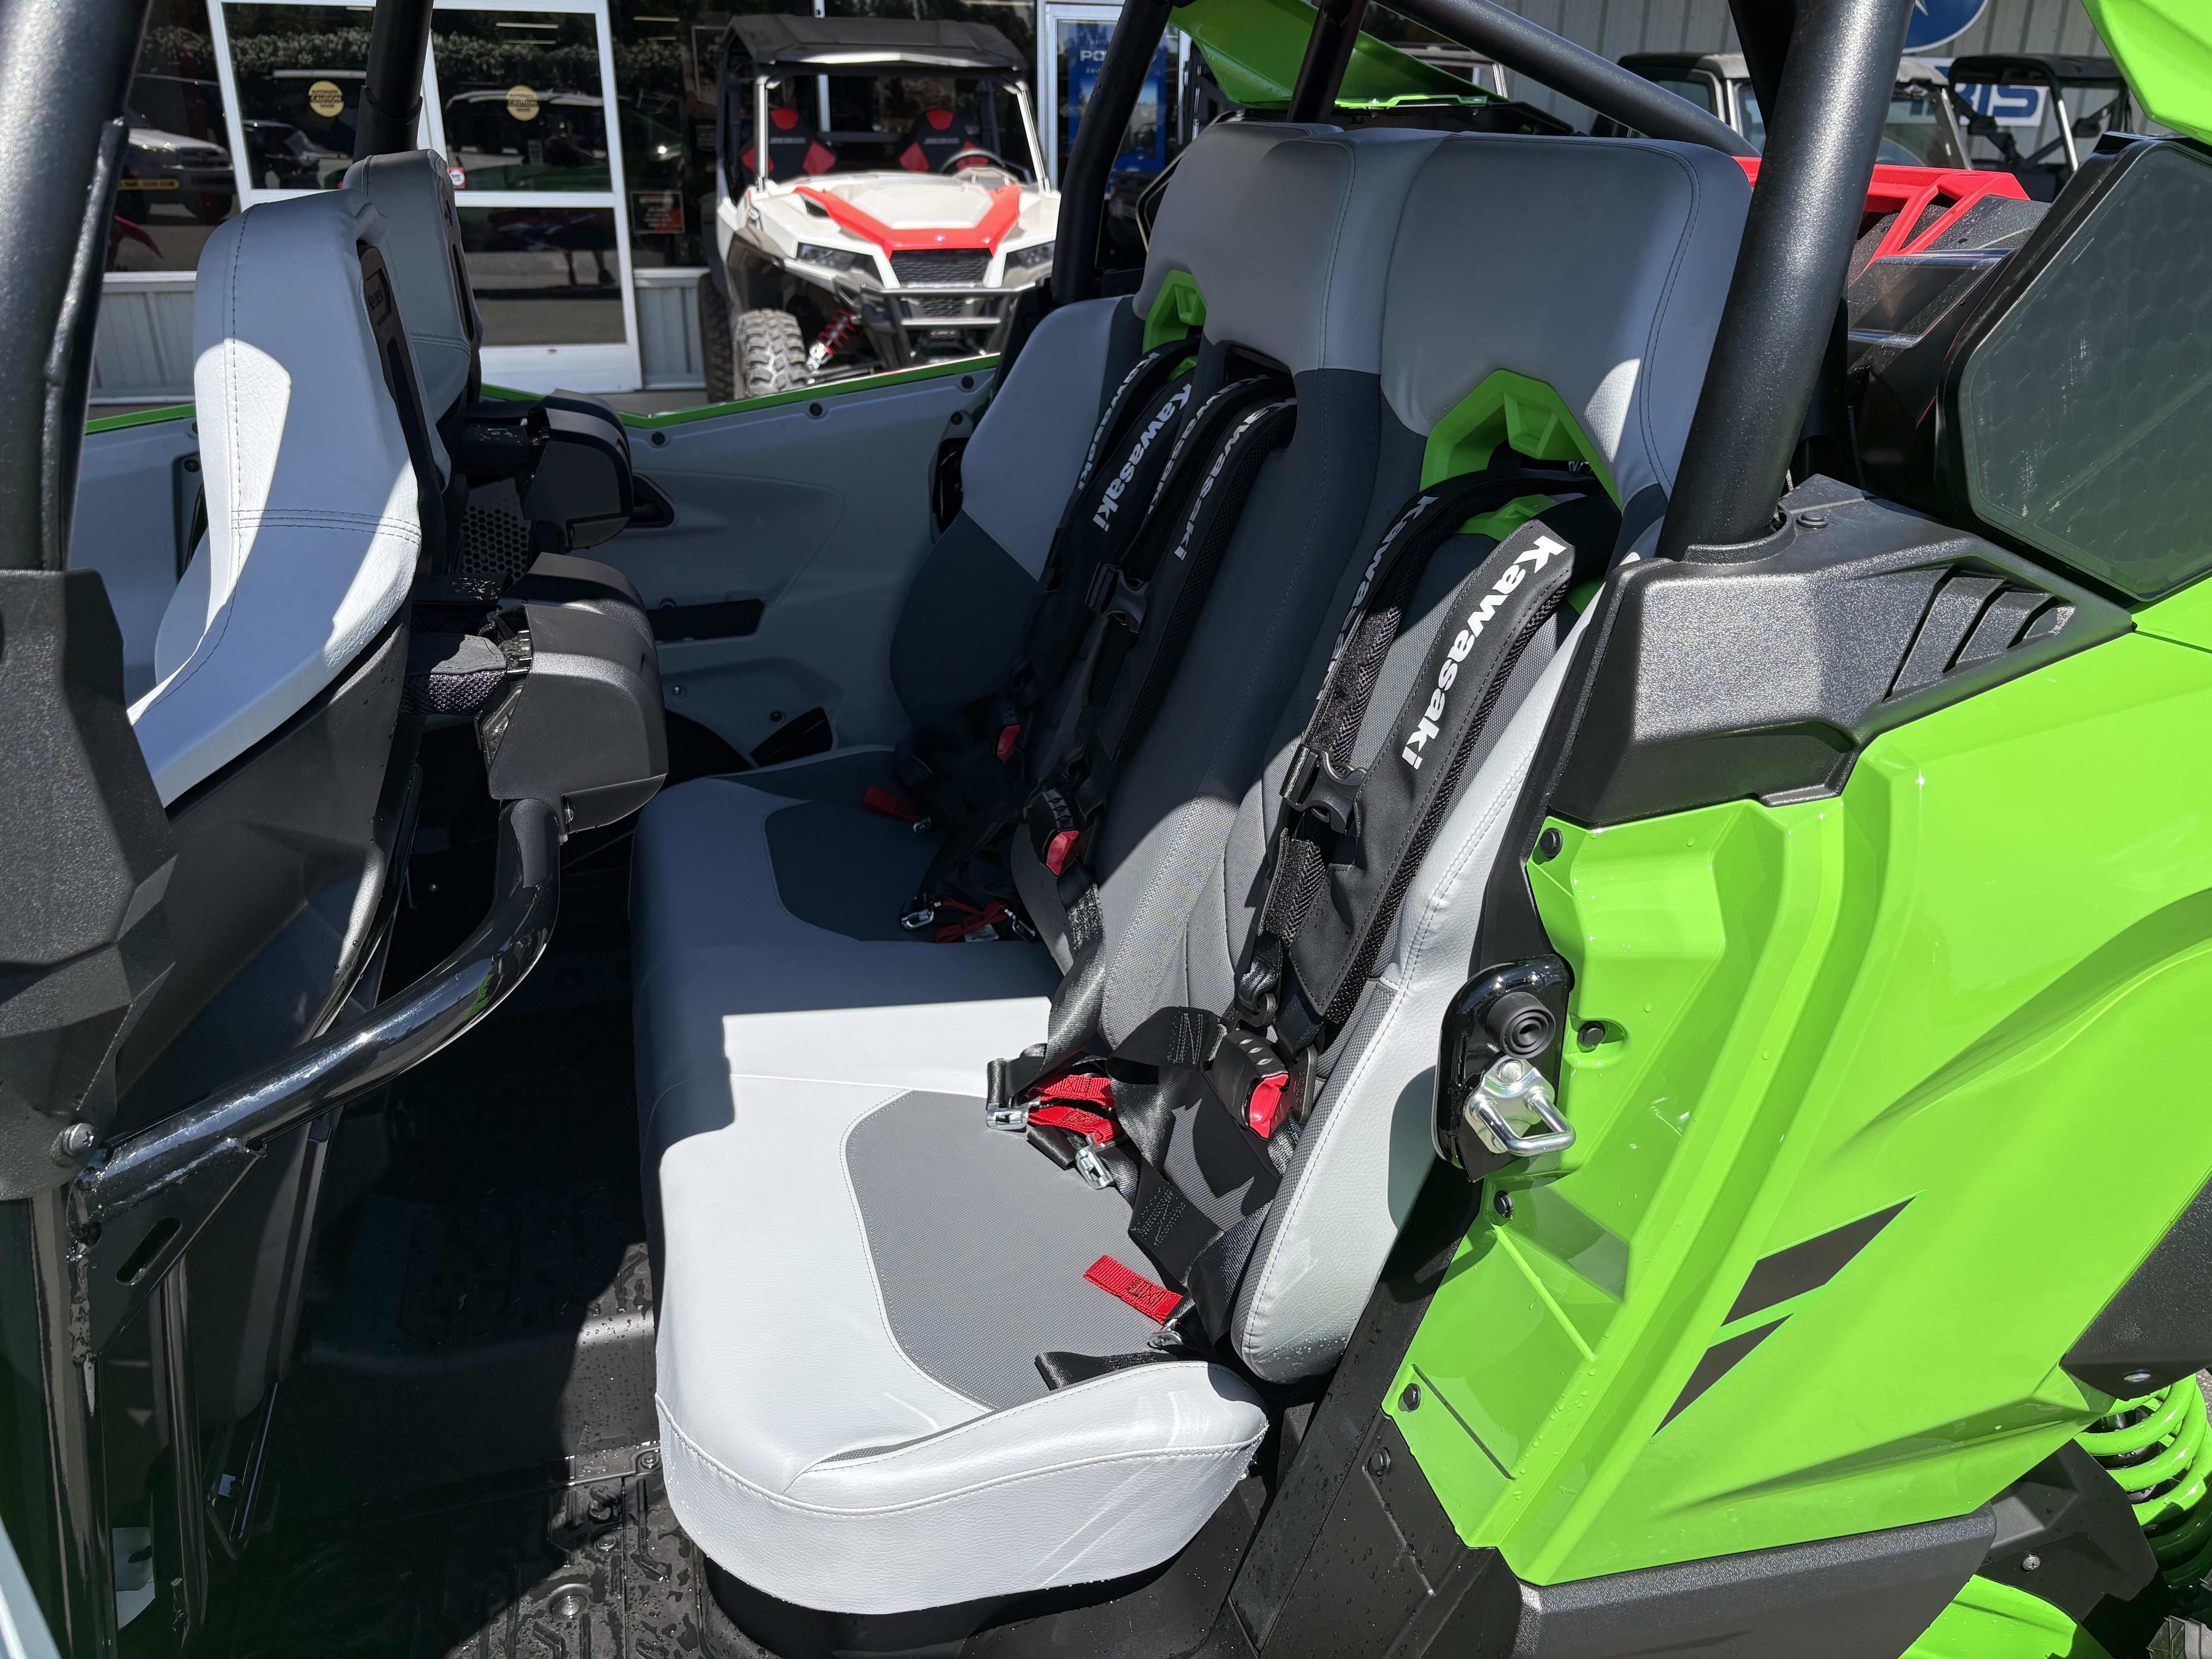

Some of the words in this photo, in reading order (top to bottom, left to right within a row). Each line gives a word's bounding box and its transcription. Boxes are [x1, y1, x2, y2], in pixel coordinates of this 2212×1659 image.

[1092, 383, 1192, 532] Kawasaki
[1147, 374, 1273, 515] Kawasaki
[1174, 397, 1297, 560] Kawasaki
[1402, 536, 1566, 769] Kawasaki
